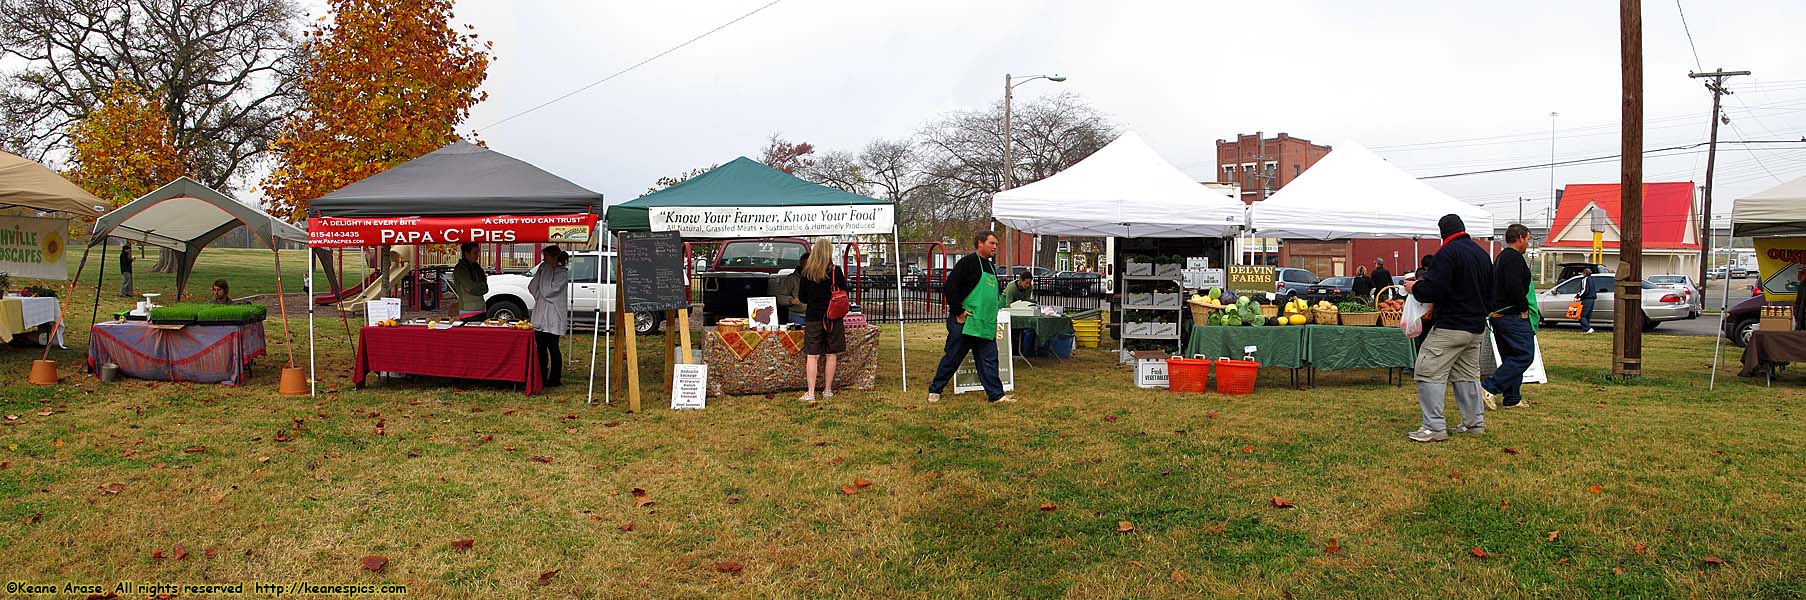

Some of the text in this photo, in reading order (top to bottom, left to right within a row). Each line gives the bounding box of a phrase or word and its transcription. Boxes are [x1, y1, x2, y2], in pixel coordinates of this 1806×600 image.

[704, 211, 731, 223] Your
[734, 211, 779, 224] Farmer,
[783, 210, 817, 222] Know
[821, 210, 847, 221] Your
[677, 225, 704, 233] Natural,
[706, 224, 735, 232] Grassfed
[765, 223, 803, 231] Sustainable
[811, 222, 845, 231] Humanely
[381, 229, 434, 243] PAPA
[470, 228, 516, 242] PIES
[1230, 266, 1273, 274] DELVIN
[1231, 274, 1272, 283] FARMS
